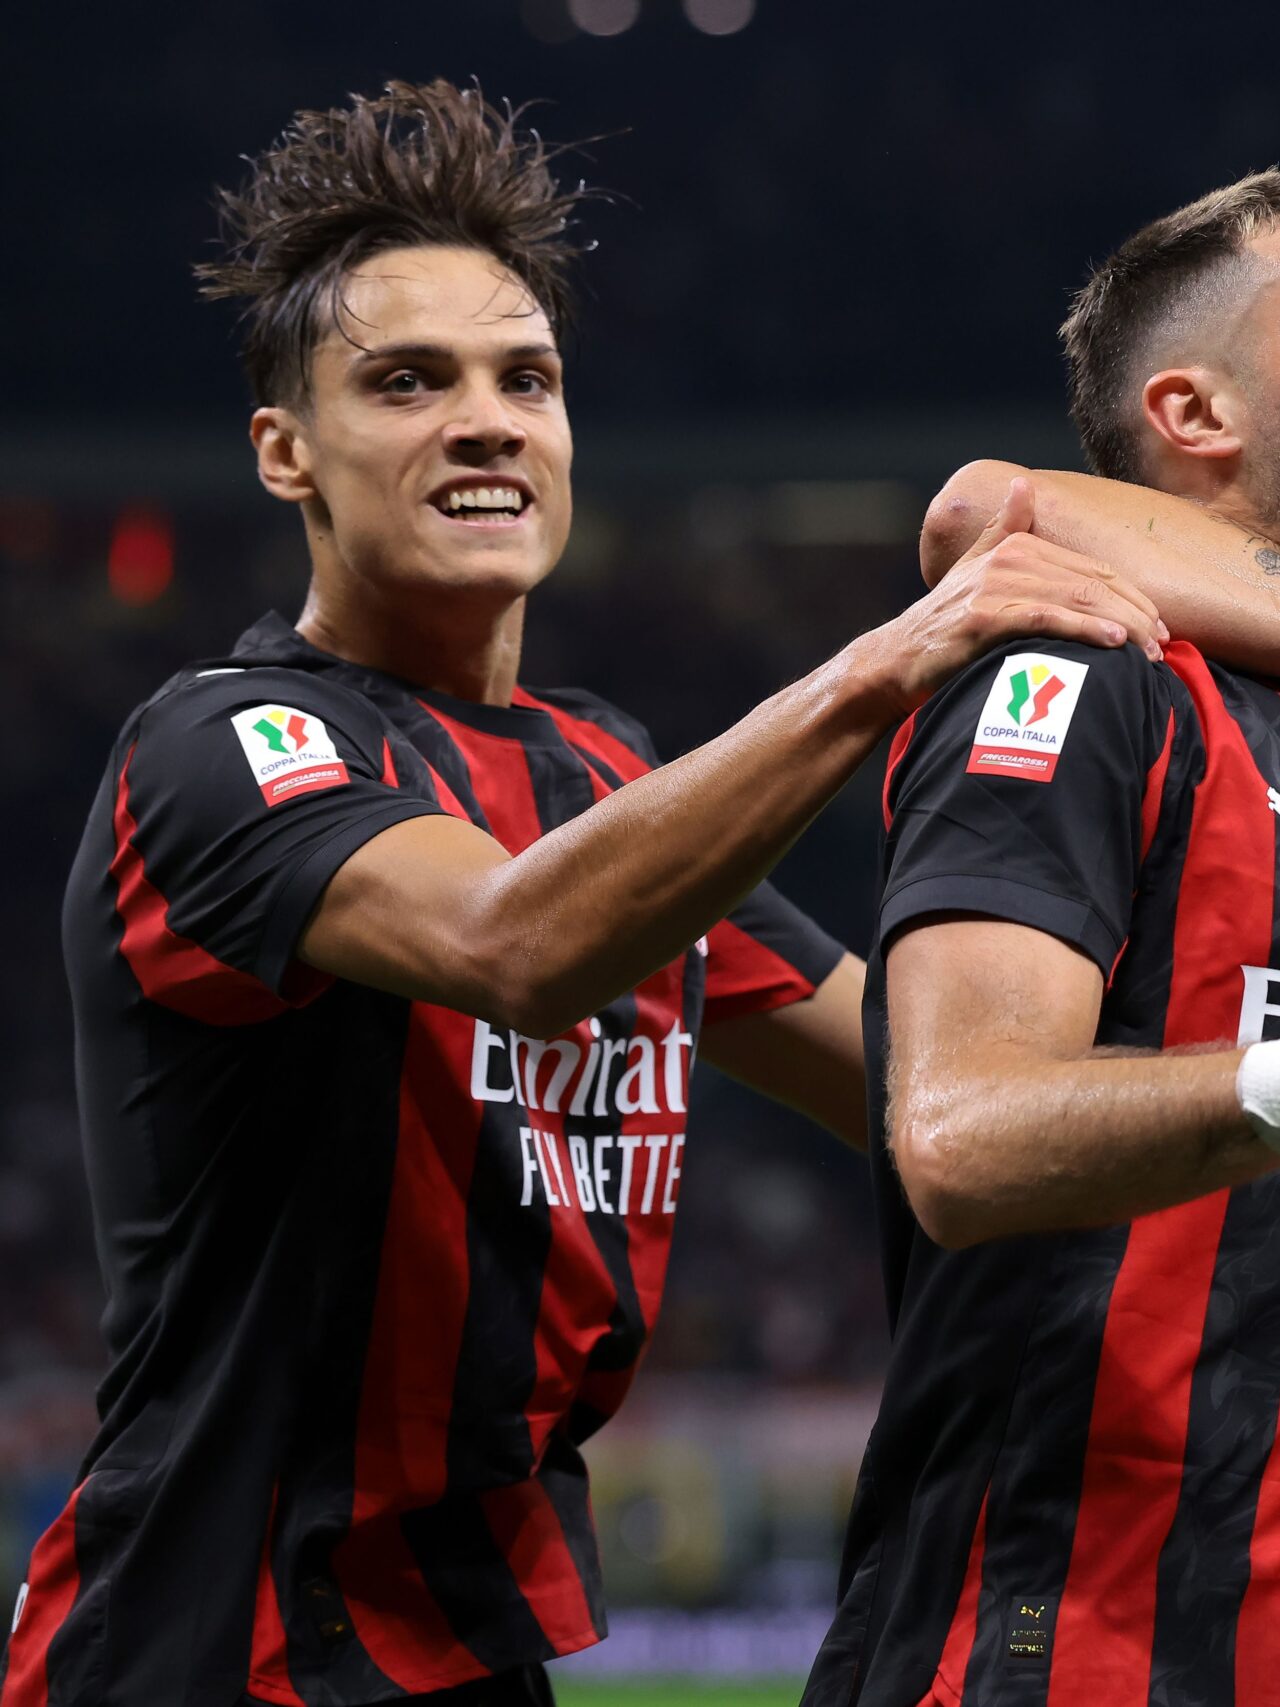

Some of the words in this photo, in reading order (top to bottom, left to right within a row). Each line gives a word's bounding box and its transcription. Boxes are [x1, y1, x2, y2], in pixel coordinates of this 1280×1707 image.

[983, 726, 1018, 738] COPPA
[1022, 730, 1057, 744] ITALIA
[260, 757, 296, 775] COPPA
[981, 753, 1048, 767] FRECCIAROSSA
[273, 771, 338, 792] FRECCIAROSSA
[519, 1127, 571, 1208] FLY
